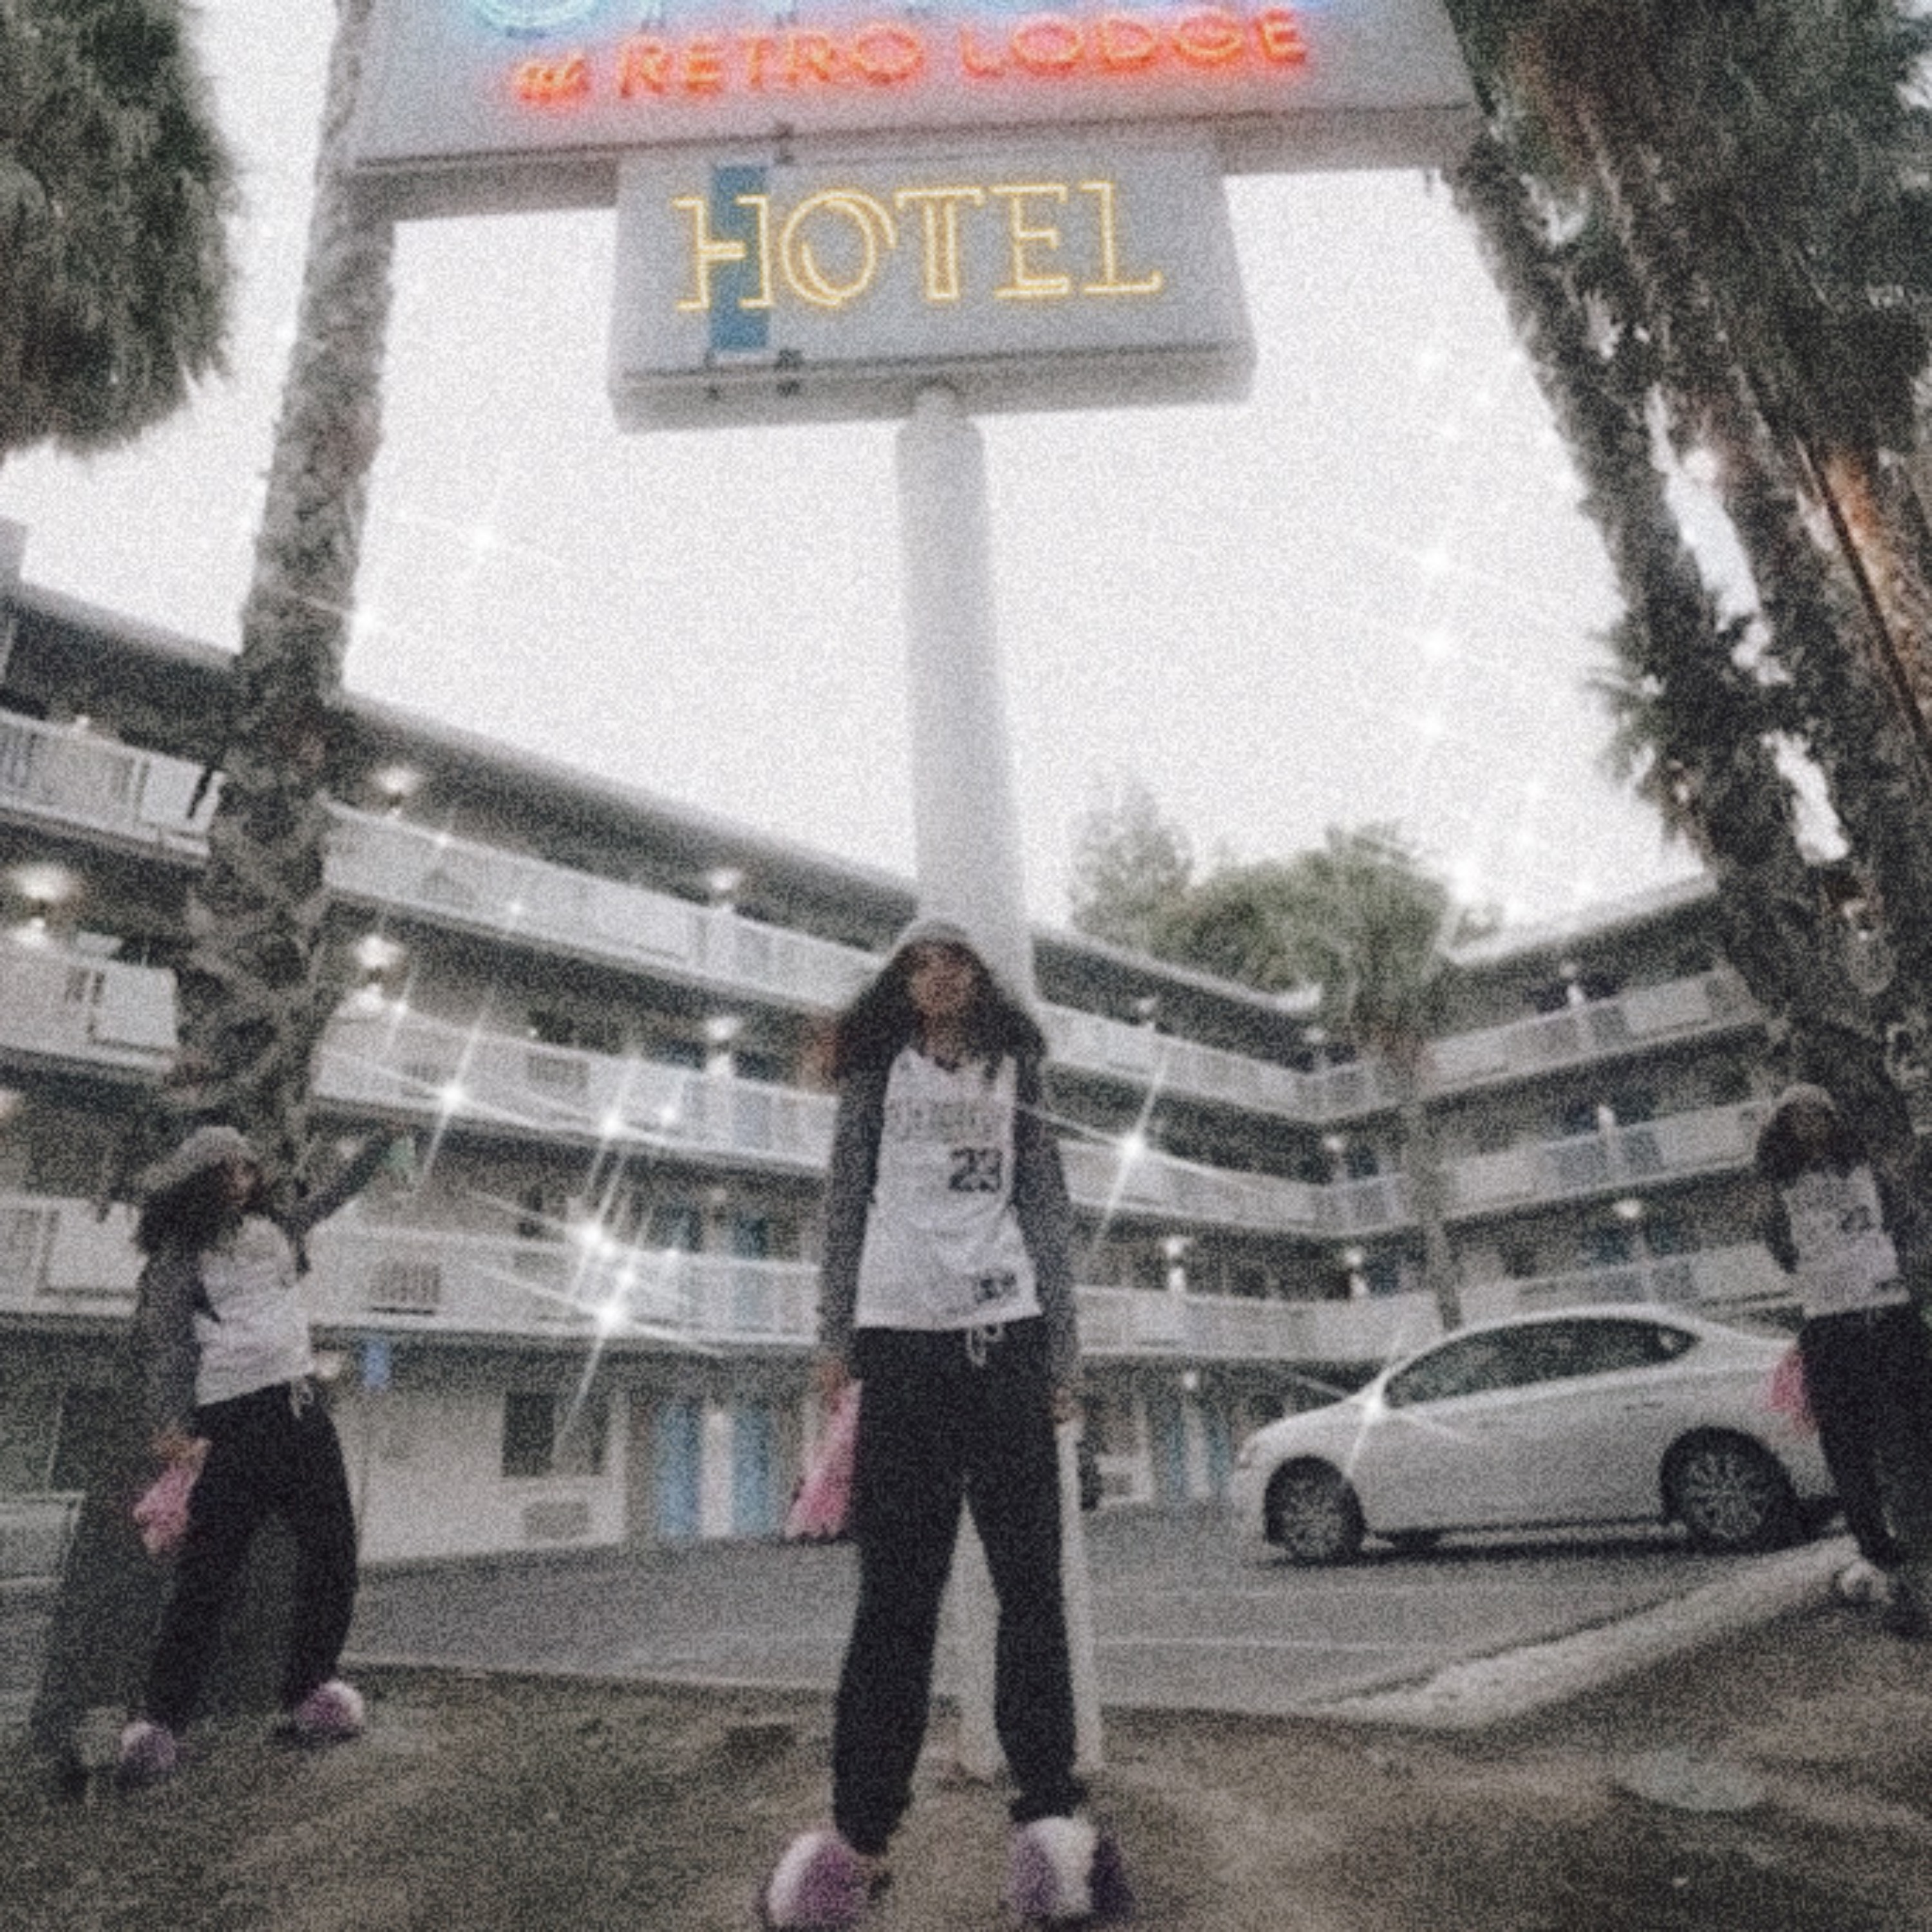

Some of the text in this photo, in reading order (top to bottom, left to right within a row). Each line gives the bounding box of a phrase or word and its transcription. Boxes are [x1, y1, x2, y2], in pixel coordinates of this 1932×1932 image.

[618, 22, 923, 99] RETRO
[958, 8, 1307, 79] LODGE
[672, 180, 1163, 312] HOTEL
[949, 1146, 1003, 1193] 23
